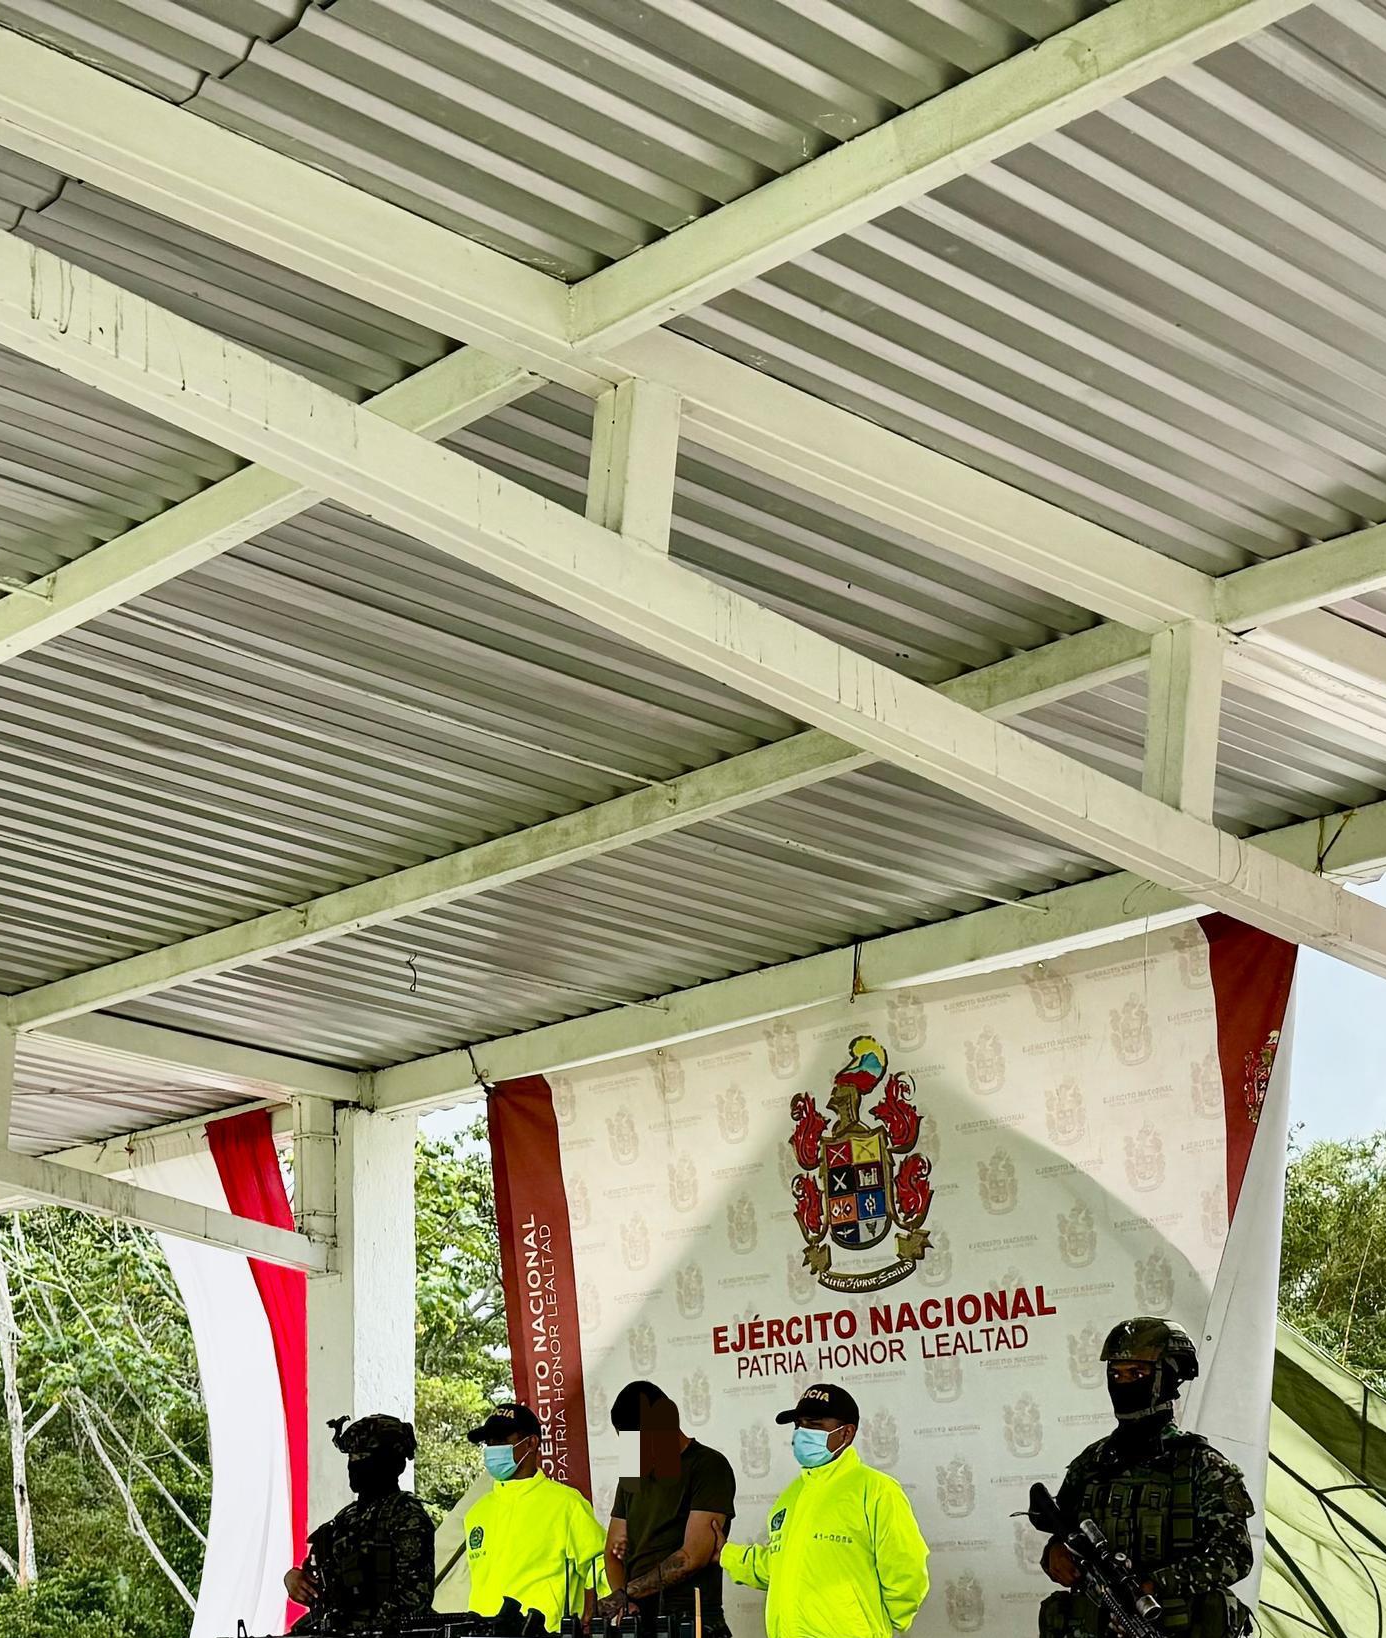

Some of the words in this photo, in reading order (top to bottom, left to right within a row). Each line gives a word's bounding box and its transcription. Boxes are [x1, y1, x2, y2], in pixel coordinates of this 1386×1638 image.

[522, 1214, 547, 1352] NACIONAL
[539, 1224, 558, 1318] LEALTAD
[712, 1313, 858, 1355] EJÉRCITO
[870, 1285, 1057, 1336] NACIONAL
[737, 1350, 808, 1379] PATRIA
[819, 1338, 907, 1370] HONOR
[921, 1325, 1029, 1360] LEALTAD
[549, 1324, 564, 1402] HONOR
[535, 1360, 555, 1481] JÉRCITO
[555, 1408, 568, 1481] PATRIA
